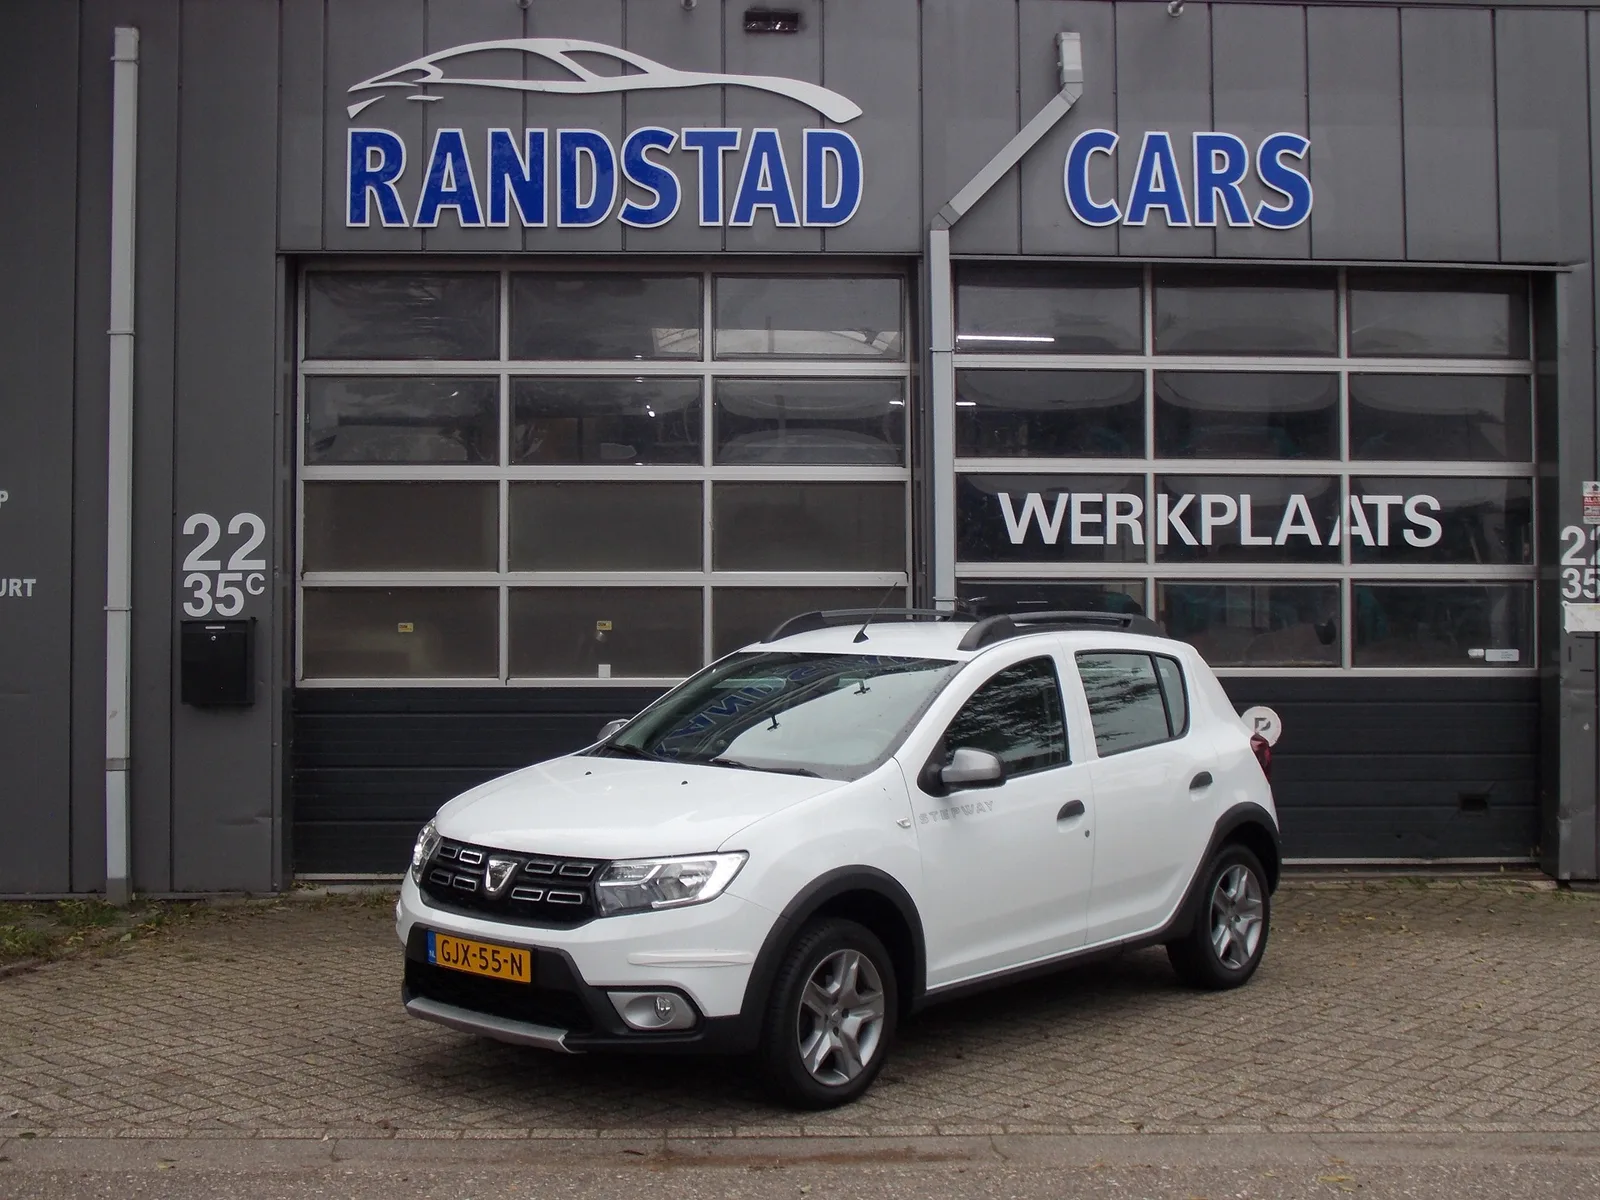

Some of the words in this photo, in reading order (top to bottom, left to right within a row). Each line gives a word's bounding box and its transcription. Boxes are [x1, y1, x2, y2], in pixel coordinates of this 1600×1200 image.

[346, 126, 864, 228] RANDSTAD
[1063, 128, 1314, 229] CARS
[182, 512, 266, 571] 22
[997, 492, 1443, 548] WERKPLAATS
[918, 800, 994, 825] STEPWAY
[441, 939, 523, 977] GJX-55-N
